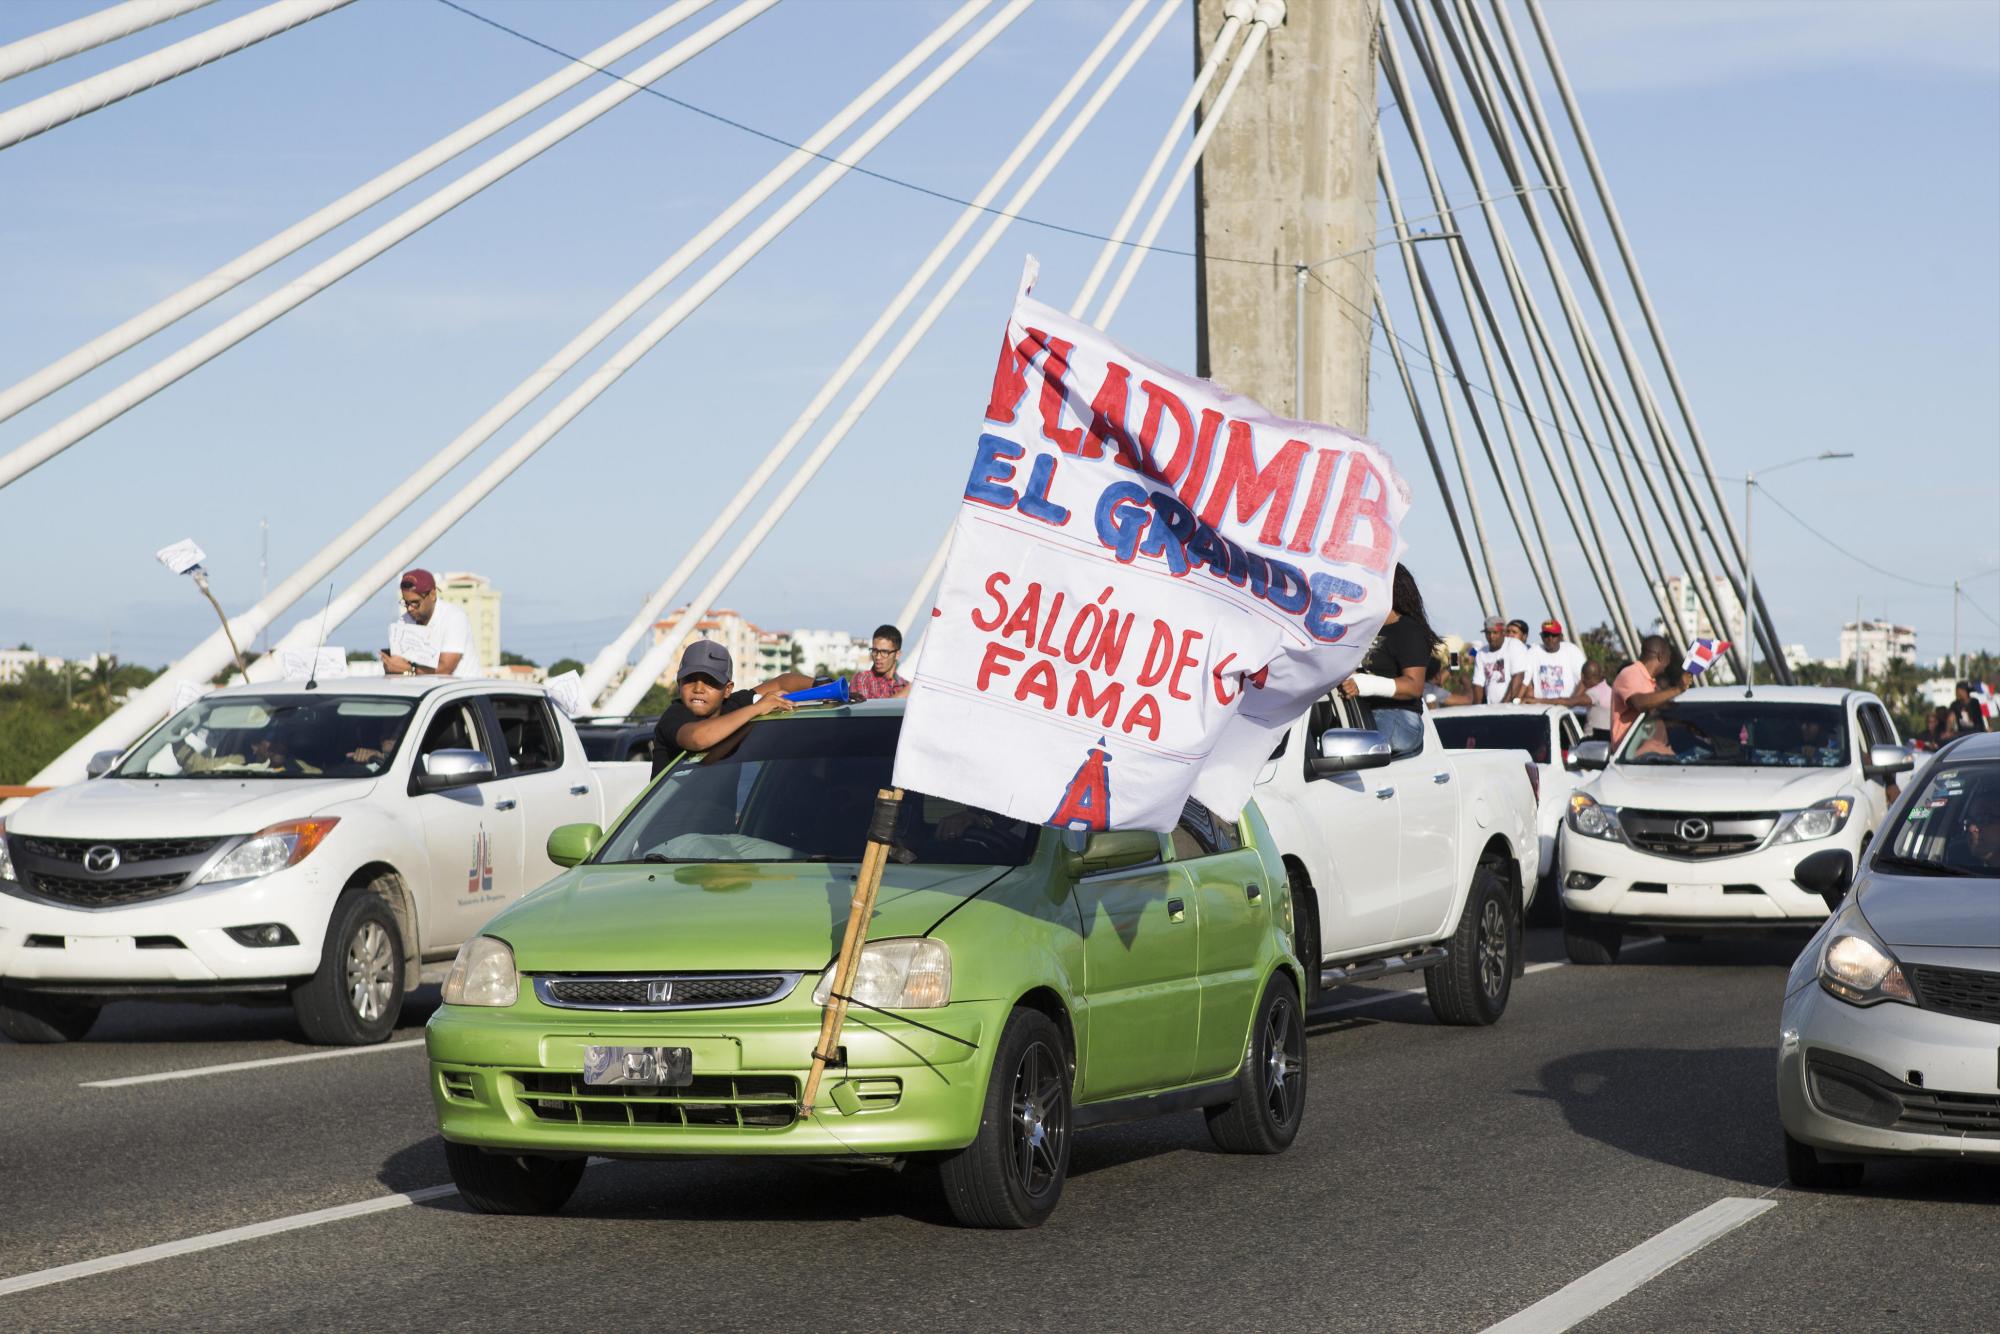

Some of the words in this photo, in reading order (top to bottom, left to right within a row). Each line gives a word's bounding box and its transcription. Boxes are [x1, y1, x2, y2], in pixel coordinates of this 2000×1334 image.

[963, 433, 1072, 526] EL
[1094, 480, 1368, 643] GRANDE
[971, 571, 1136, 677] SALÓN
[1136, 618, 1204, 701] DE
[976, 641, 1162, 742] FAMA
